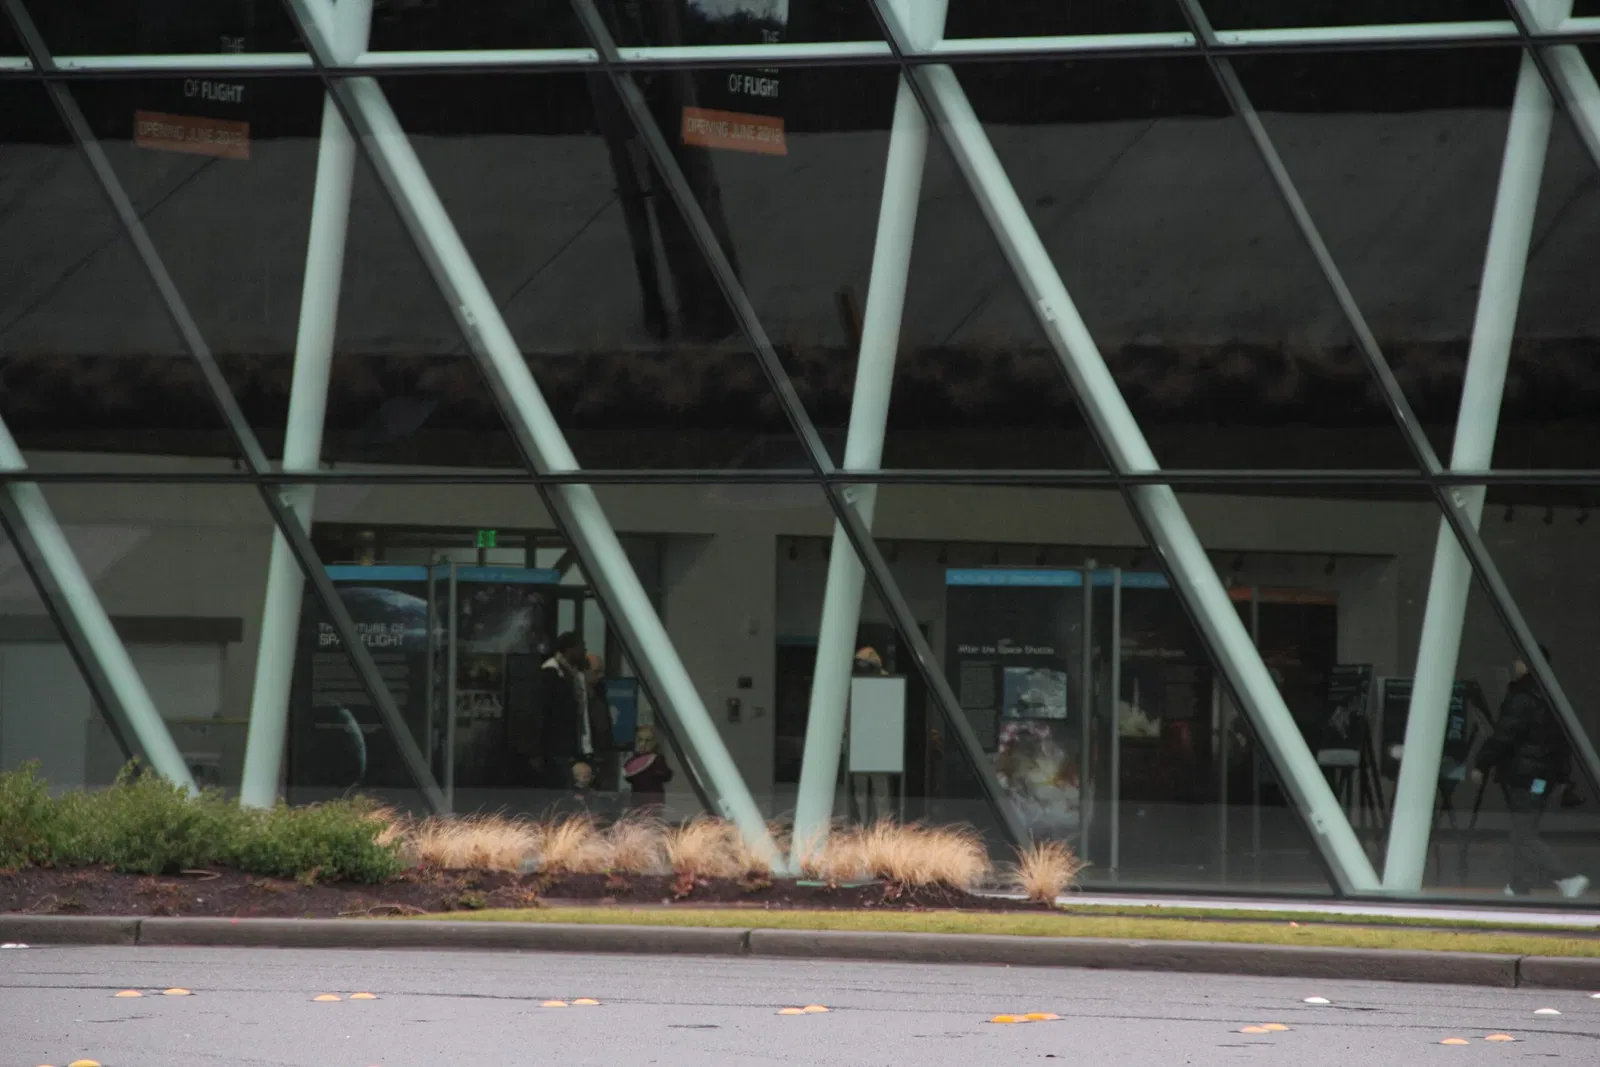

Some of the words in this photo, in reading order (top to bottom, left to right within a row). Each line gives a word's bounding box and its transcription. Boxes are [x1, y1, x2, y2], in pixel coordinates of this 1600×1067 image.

[184, 79, 200, 97] OF
[201, 81, 245, 103] FLIGHT
[729, 74, 743, 93] OF
[744, 76, 779, 98] FLIGHT
[139, 121, 184, 139] OPENING
[686, 118, 729, 138] OPENING
